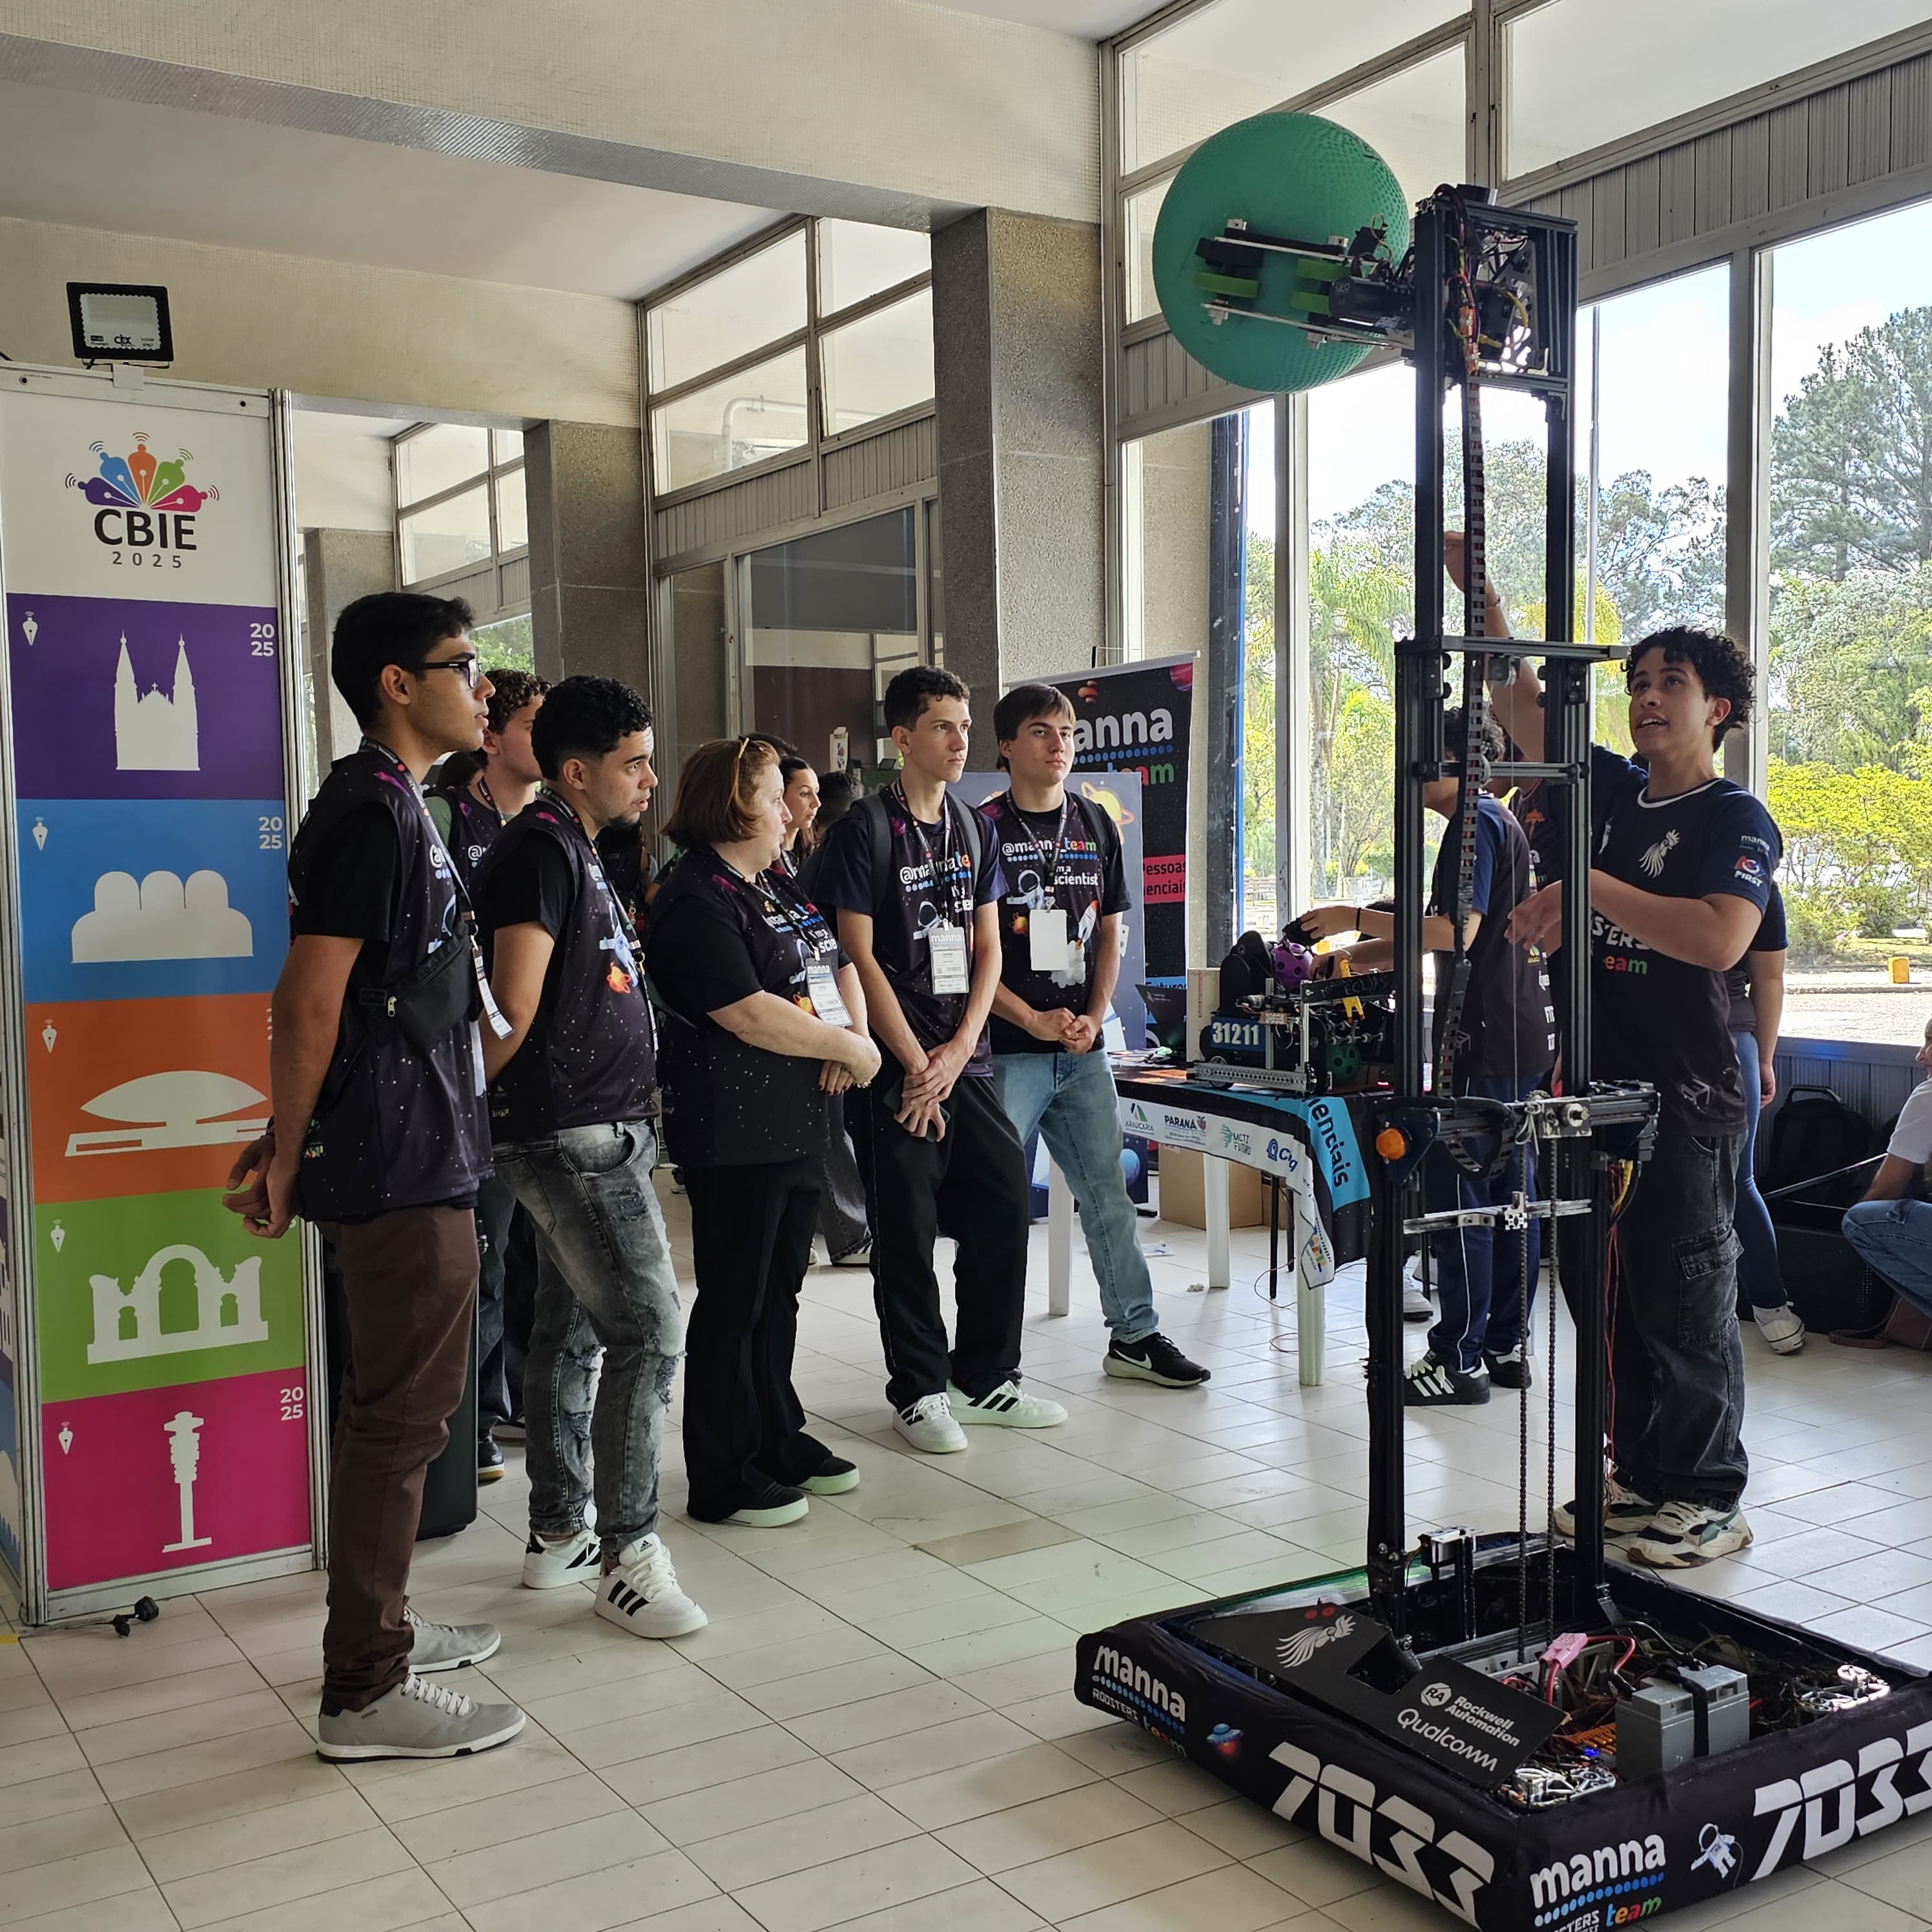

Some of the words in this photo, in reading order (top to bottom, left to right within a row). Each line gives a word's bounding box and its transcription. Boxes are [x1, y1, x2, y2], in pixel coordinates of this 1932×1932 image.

[94, 509, 197, 550] CBIE
[112, 551, 182, 569] 2025
[249, 622, 275, 639] 20
[251, 641, 274, 657] 25
[1073, 708, 1173, 752] anna
[258, 816, 282, 831] 20
[259, 835, 282, 849] 25
[1054, 872, 1098, 885] scientist
[1734, 870, 1763, 887] FIRST
[930, 934, 962, 943] manna
[807, 965, 830, 974] manna
[1603, 955, 1648, 974] eam
[1213, 1022, 1259, 1045] 31211
[280, 1386, 304, 1403] 20
[280, 1404, 304, 1421] 25
[1093, 1645, 1186, 1722] manna
[1425, 1687, 1446, 1702] RA
[1092, 1687, 1139, 1721] ROOSTERS
[1454, 1696, 1515, 1730] Rockwell
[1444, 1704, 1521, 1747] Automation
[1269, 1742, 1495, 1932] 7033
[1530, 1834, 1666, 1909] manna
[1606, 1896, 1662, 1927] team
